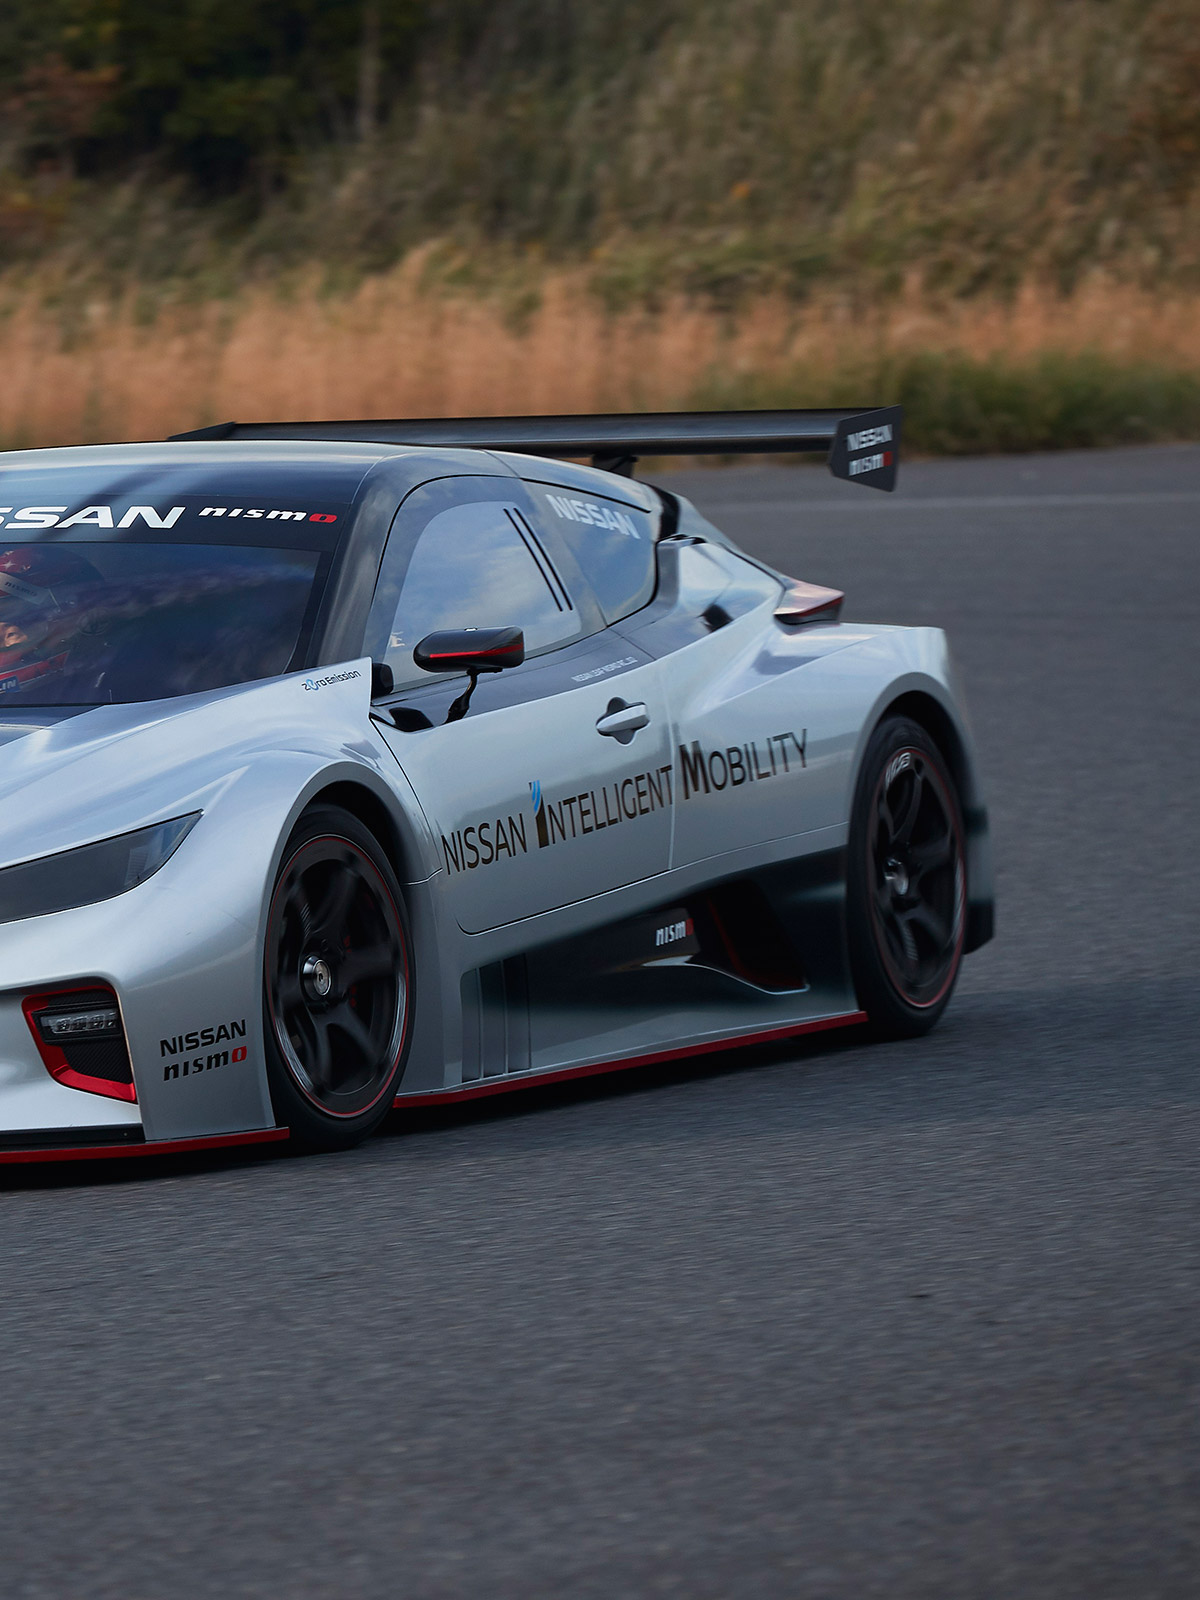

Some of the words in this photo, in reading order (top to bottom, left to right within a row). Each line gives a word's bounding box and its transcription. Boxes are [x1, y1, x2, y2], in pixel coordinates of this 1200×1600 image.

[847, 424, 893, 452] NISSAN
[199, 506, 338, 524] nismo
[545, 494, 641, 540] NISSAN
[441, 812, 528, 876] NISSAN
[528, 764, 674, 849] INTELLIGENT
[678, 728, 808, 800] MOBILITY
[160, 1019, 246, 1058] NISSAN
[163, 1045, 248, 1082] nismo
